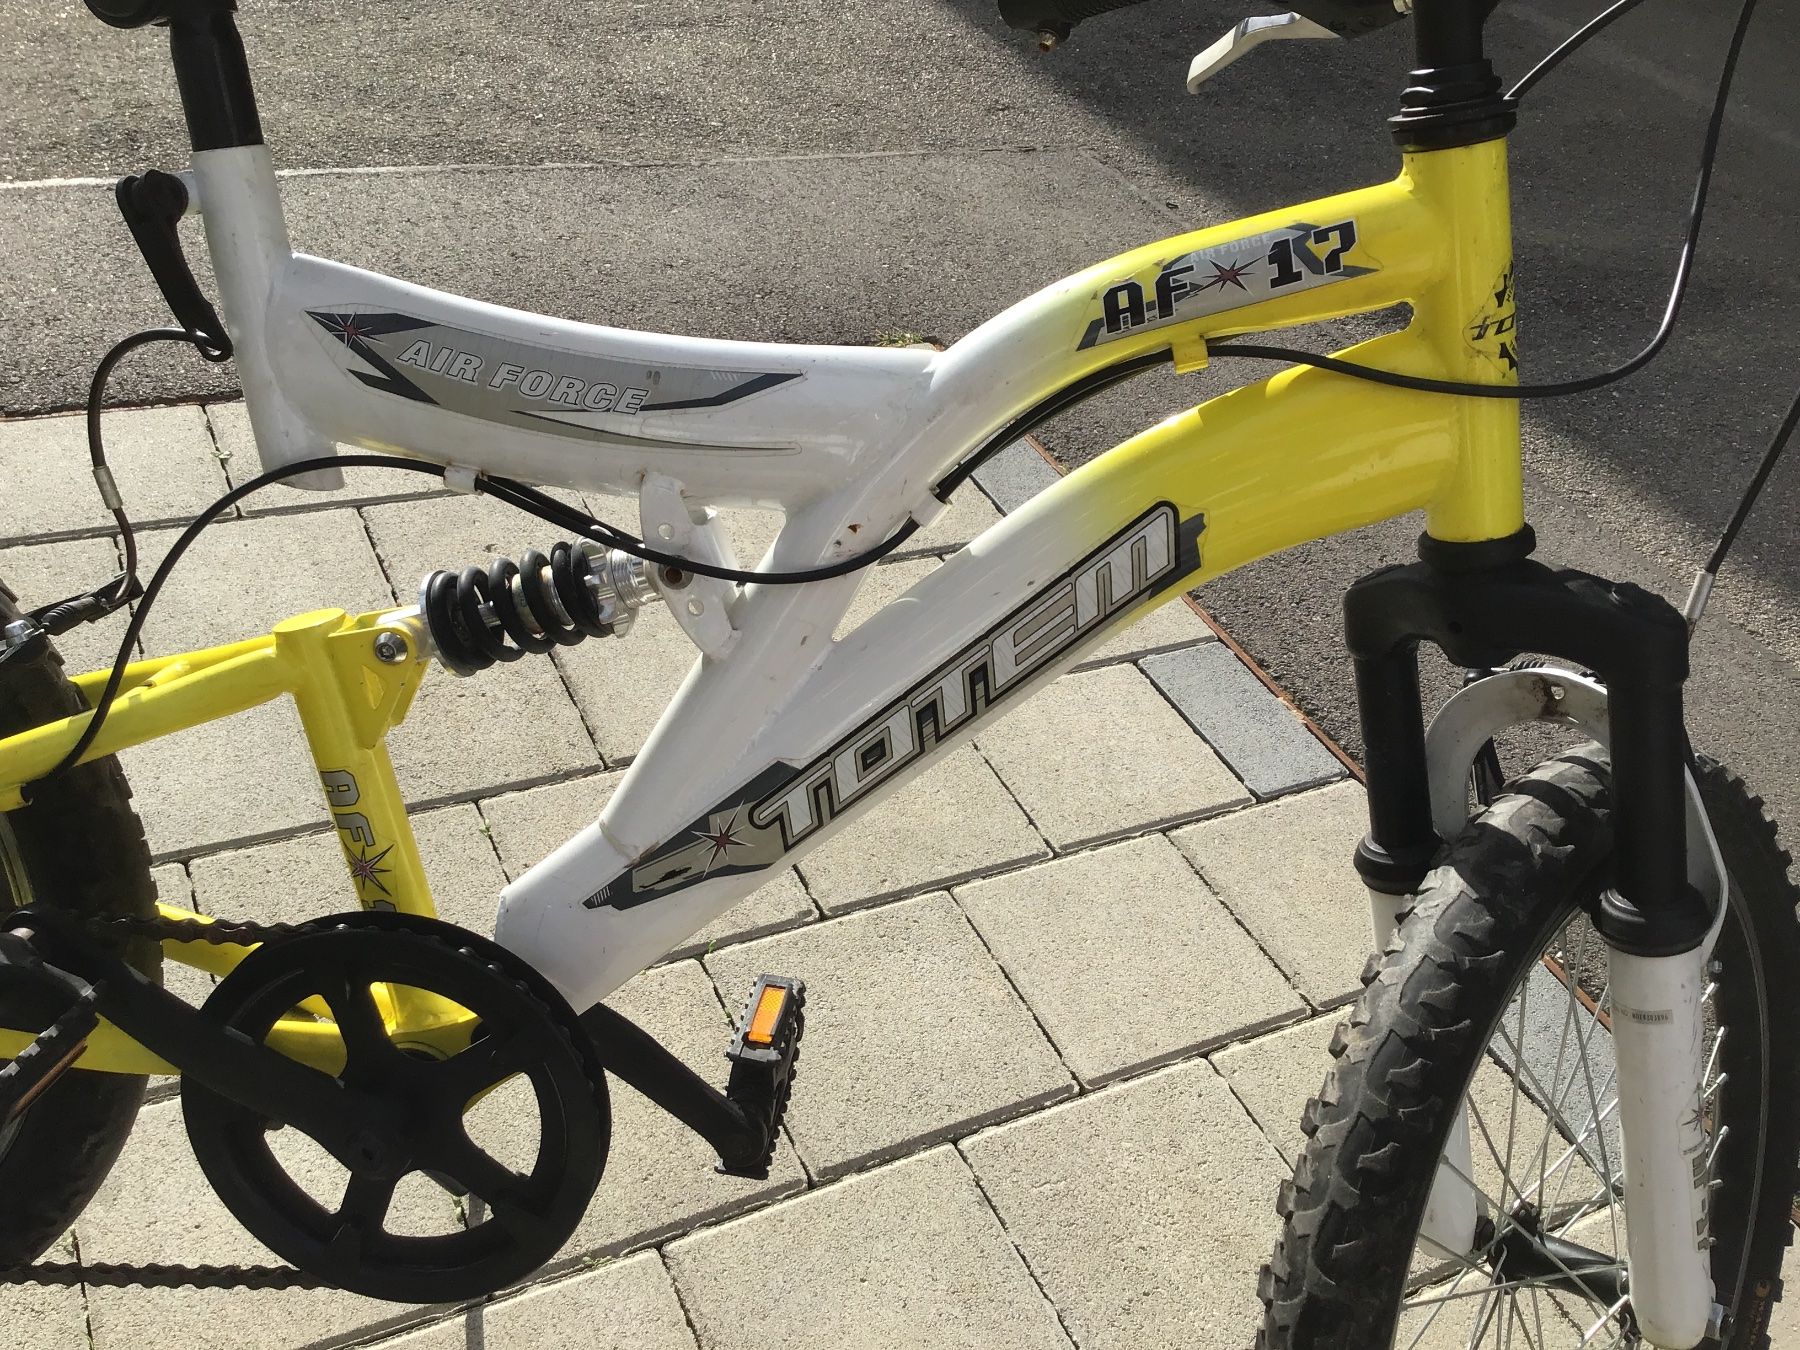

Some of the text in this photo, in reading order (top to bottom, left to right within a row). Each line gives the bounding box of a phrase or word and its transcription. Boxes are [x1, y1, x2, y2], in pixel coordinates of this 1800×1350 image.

[1190, 235, 1272, 263] AIR FORCE
[397, 338, 650, 416] AIR FORCE
[750, 500, 1181, 852] TOTEM
